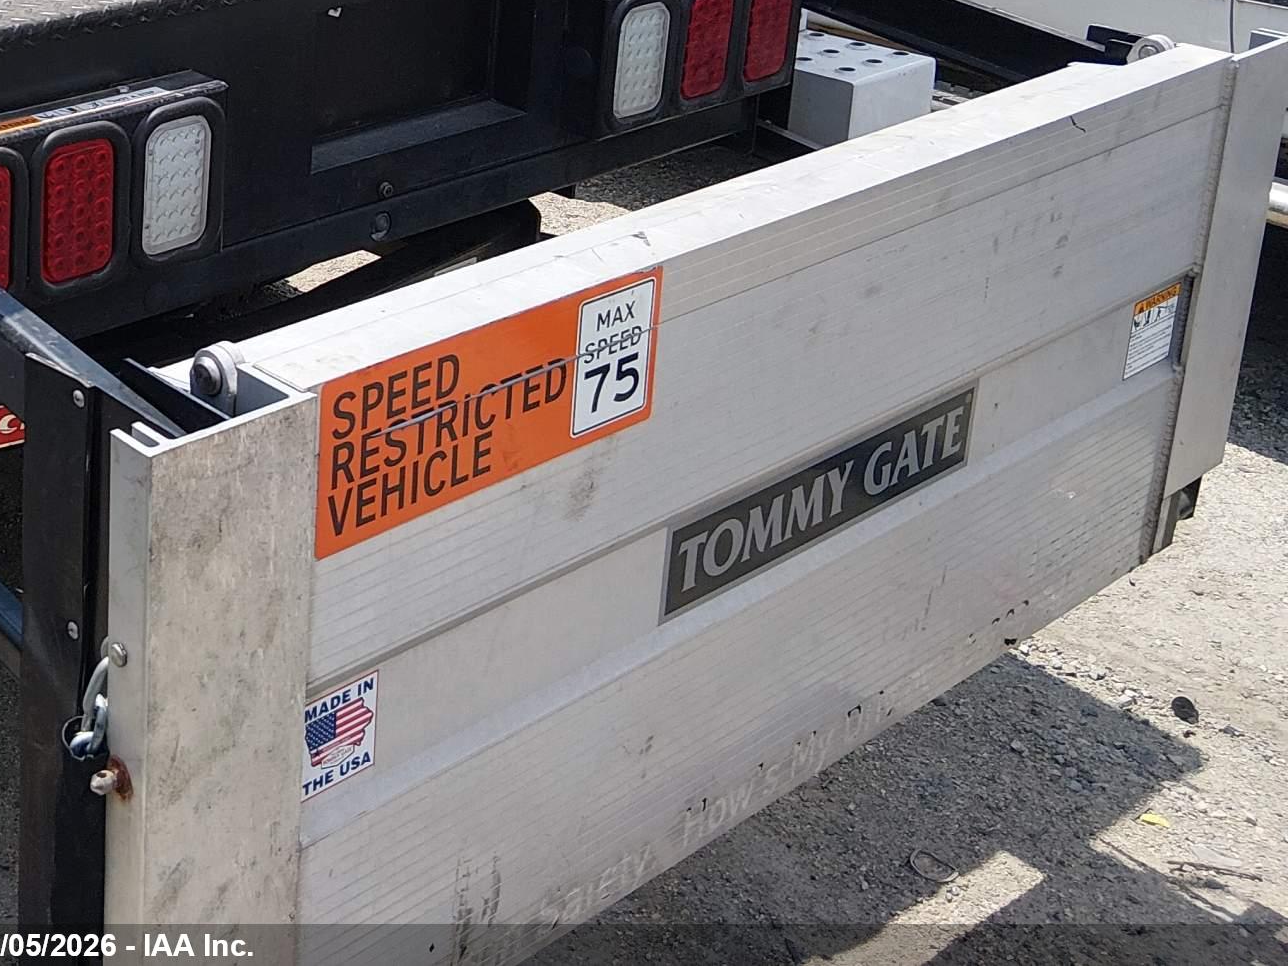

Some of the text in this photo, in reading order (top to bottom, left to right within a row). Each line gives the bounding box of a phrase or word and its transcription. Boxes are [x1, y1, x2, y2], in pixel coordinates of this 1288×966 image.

[596, 300, 636, 332] MAX
[1143, 285, 1179, 312] WARNING
[583, 325, 643, 365] SPEED
[332, 353, 461, 440] SPEED
[584, 352, 640, 414] 75
[331, 357, 567, 490] RESTRICTED
[327, 431, 493, 536] VEHICLE
[678, 406, 964, 593] TOMMY GATE
[304, 677, 374, 724] MADE IN
[302, 770, 334, 796] THE
[339, 751, 371, 777] USA
